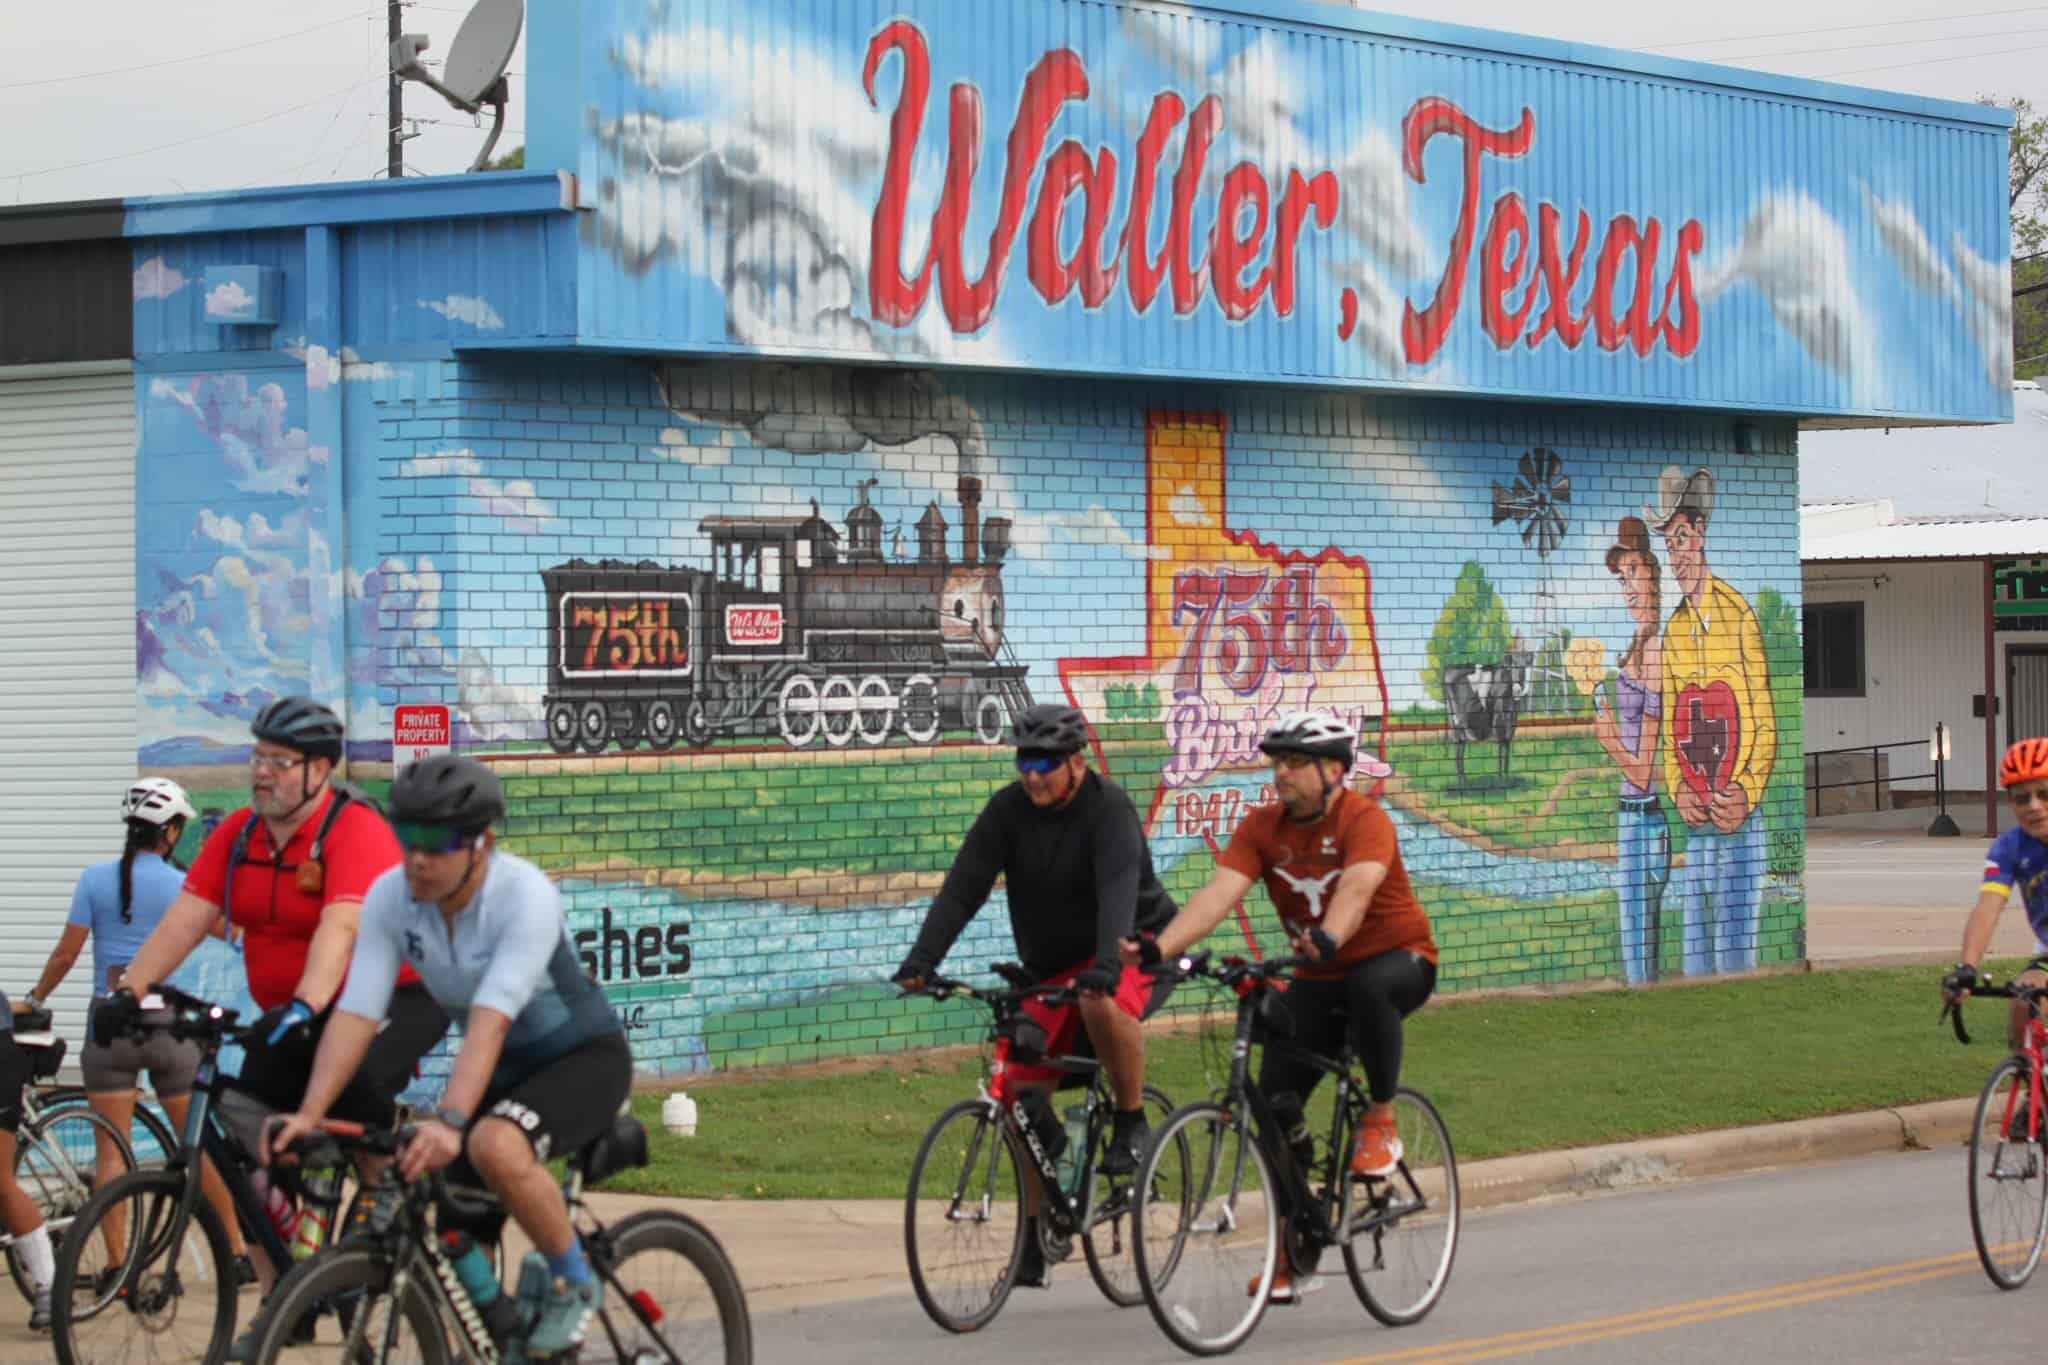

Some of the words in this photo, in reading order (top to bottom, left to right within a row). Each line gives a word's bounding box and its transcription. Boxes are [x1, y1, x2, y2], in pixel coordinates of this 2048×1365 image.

[864, 19, 1358, 340] Waller,
[1402, 95, 1704, 365] Texas
[573, 600, 688, 670] 75th
[1172, 564, 1347, 700] 75th
[396, 729, 446, 743] PROPERTY
[401, 713, 441, 728] PRIVATE
